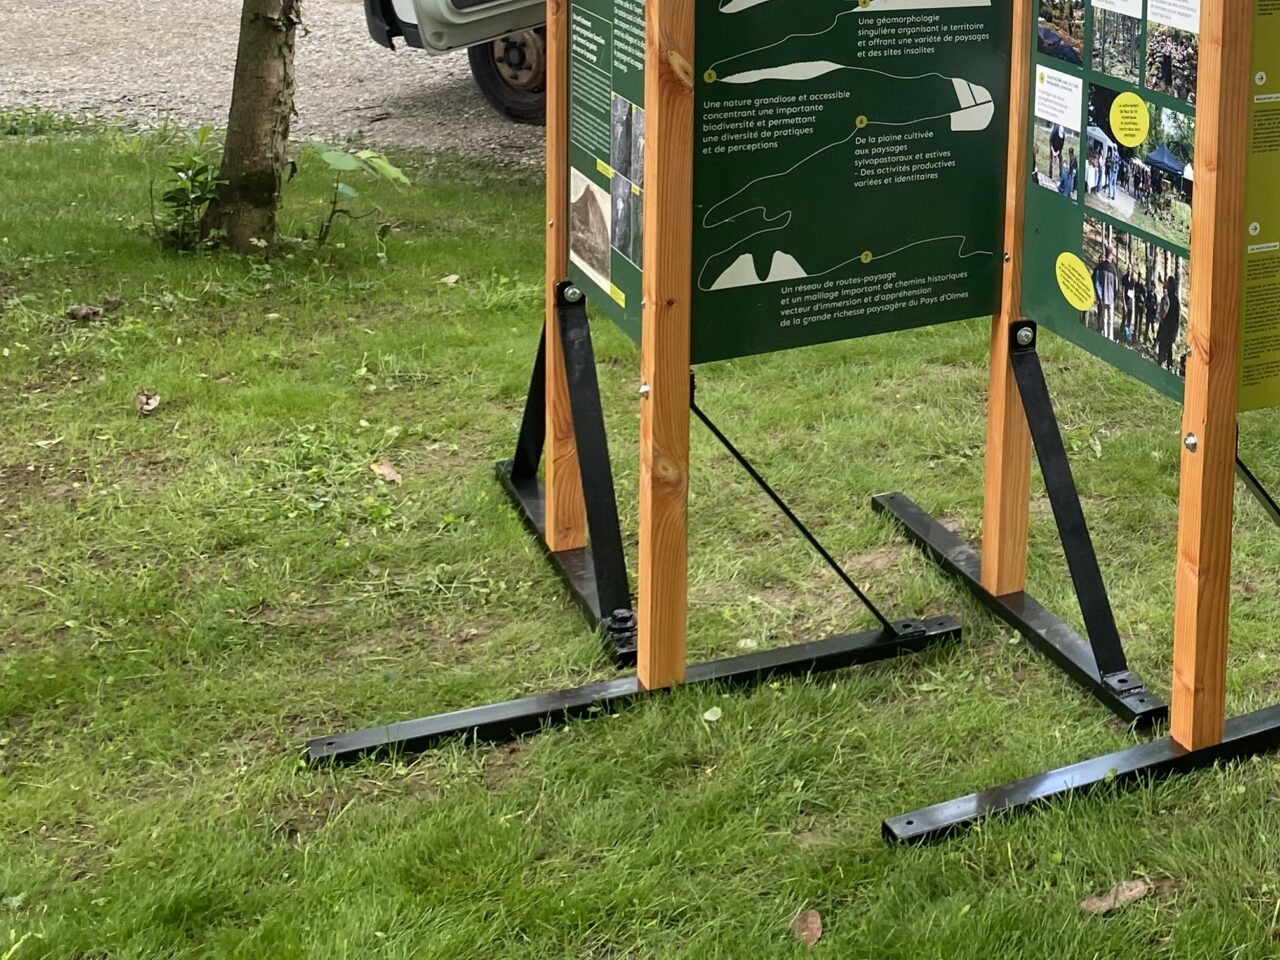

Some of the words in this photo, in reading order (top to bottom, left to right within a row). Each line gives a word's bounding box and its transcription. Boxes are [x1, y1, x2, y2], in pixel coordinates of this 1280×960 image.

[858, 17, 874, 25] Une
[875, 13, 940, 26] géomorphologie
[857, 26, 895, 37] singulière
[897, 24, 939, 35] organisant
[949, 22, 984, 31] territoire
[857, 39, 866, 47] et
[867, 37, 896, 46] offrant
[913, 34, 941, 43] variété
[942, 34, 953, 42] de
[954, 33, 989, 43] paysages
[867, 49, 881, 57] des
[883, 48, 901, 56] sites
[903, 46, 935, 54] insolites
[703, 100, 721, 108] Une
[723, 99, 752, 107] nature
[753, 95, 796, 107] grandiose
[809, 90, 850, 100] accessible
[702, 109, 755, 119] concentrant
[775, 104, 823, 115] importante
[702, 119, 755, 131] biodiversité
[756, 119, 766, 127] et
[767, 115, 816, 128] permettant
[702, 135, 719, 143] une
[720, 130, 758, 141] diversité
[760, 129, 772, 138] de
[773, 127, 814, 138] pratiques
[855, 136, 866, 144] De
[868, 135, 875, 143] la
[877, 133, 902, 144] plaine
[903, 130, 933, 140] cultivée
[702, 146, 712, 154] et
[714, 144, 725, 153] de
[727, 140, 778, 154] perceptions
[871, 144, 907, 155] paysages
[854, 154, 913, 167] sylvopastoraux
[914, 152, 923, 160] et
[924, 150, 951, 159] estives
[860, 168, 875, 176] Des
[876, 164, 910, 174] activités
[911, 160, 956, 172] productives
[780, 286, 792, 294] Un
[794, 282, 821, 292] réseau
[823, 280, 834, 288] de
[835, 271, 896, 286] routes-paysage
[780, 297, 789, 305] et
[803, 290, 839, 301] maillage
[841, 283, 881, 296] important
[882, 282, 893, 290] de
[894, 277, 926, 288] chemins
[927, 271, 968, 283] historiques
[779, 318, 790, 327] de
[792, 317, 801, 325] la
[802, 312, 831, 325] grande
[833, 308, 865, 318] richesse
[866, 301, 907, 315] paysagère
[919, 296, 938, 304] Pays
[939, 291, 968, 301] d'Olmes
